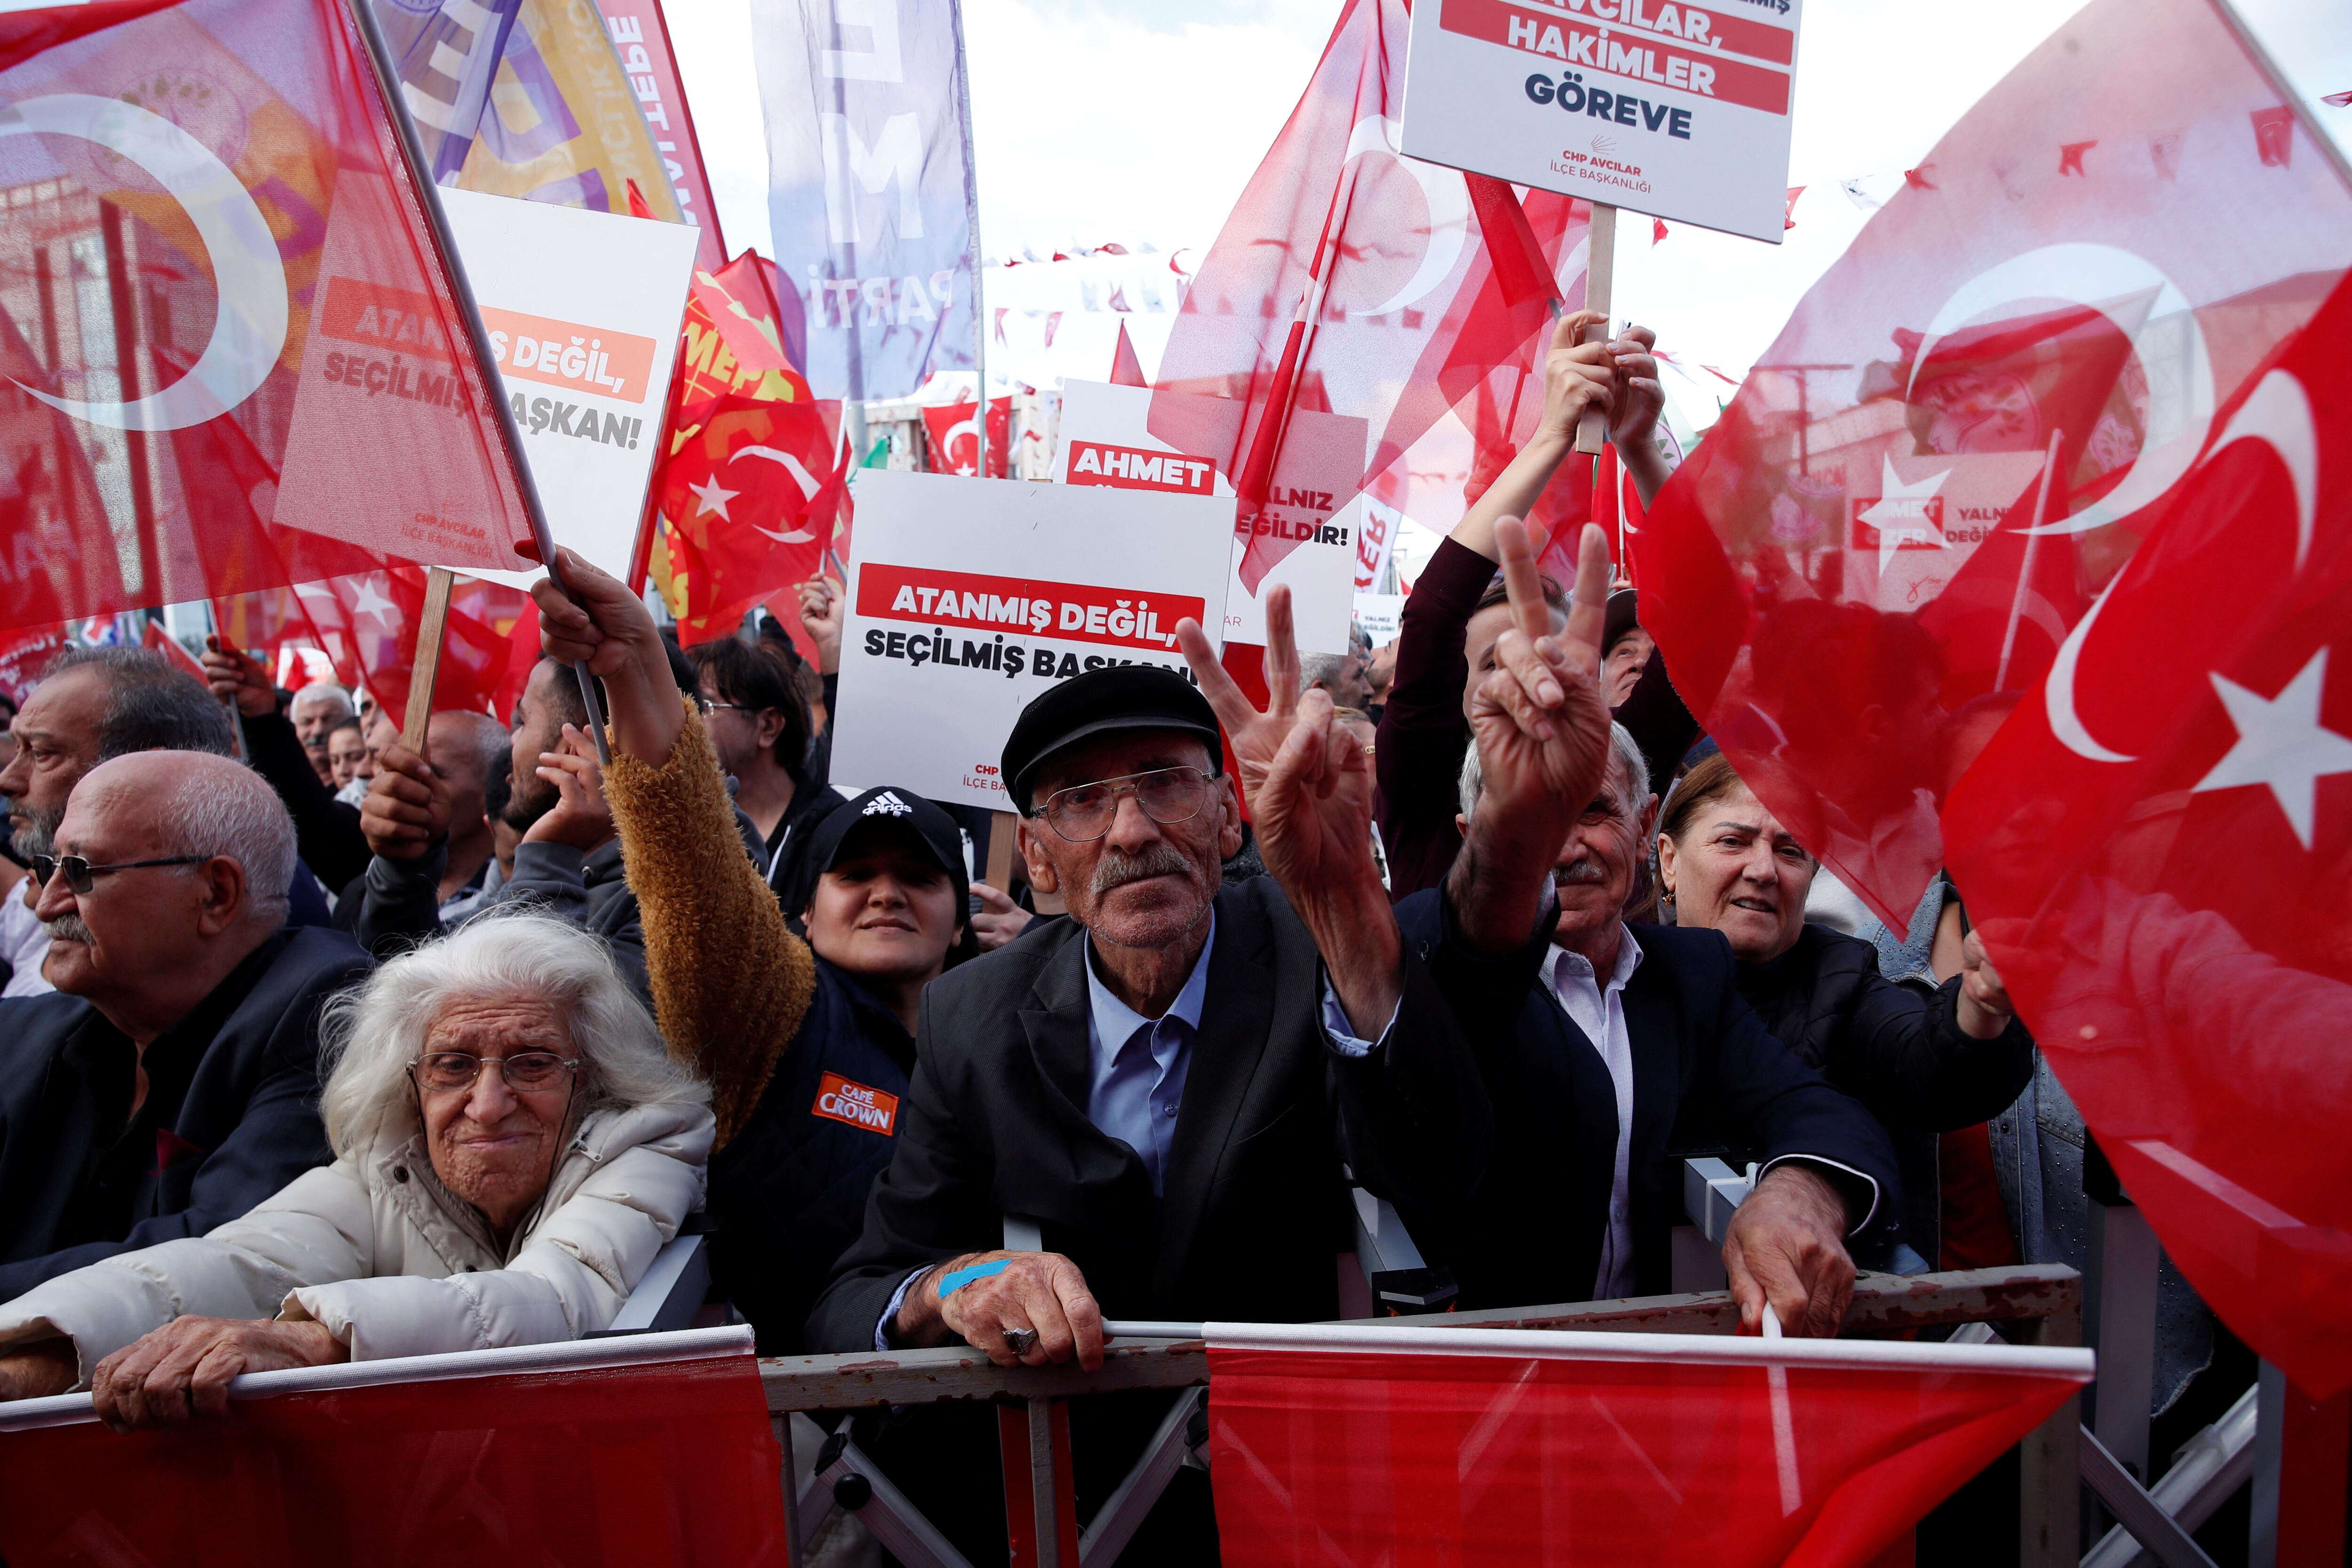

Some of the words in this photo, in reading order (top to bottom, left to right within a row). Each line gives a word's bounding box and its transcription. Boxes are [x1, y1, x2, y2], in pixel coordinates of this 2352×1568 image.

[1508, 15, 1716, 96] HAKİMLER
[1525, 71, 1692, 140] GÖREVE
[1550, 159, 1576, 176] İLÇE
[1579, 168, 1651, 193] BAŞKANLIĞI
[1563, 150, 1587, 163] CHP
[1589, 157, 1641, 177] AVCILAR
[512, 335, 626, 394] DEĞİL,
[510, 392, 643, 450] AŞKAN!
[1073, 448, 1210, 488] AHMET
[1266, 486, 1334, 512] LNIZ
[1957, 506, 2008, 520] YALN
[1235, 512, 1349, 546] EĞİLDİR!
[891, 585, 1053, 634] ATANMIŞ
[1058, 599, 1177, 648] DEĞİL,
[864, 627, 1025, 679] SEÇİLMİŞ
[963, 774, 987, 789] İLÇE
[975, 764, 999, 775] CHP
[862, 803, 913, 814] adidas
[819, 1092, 890, 1129] CROWN
[841, 1084, 874, 1104] CAFÉ
